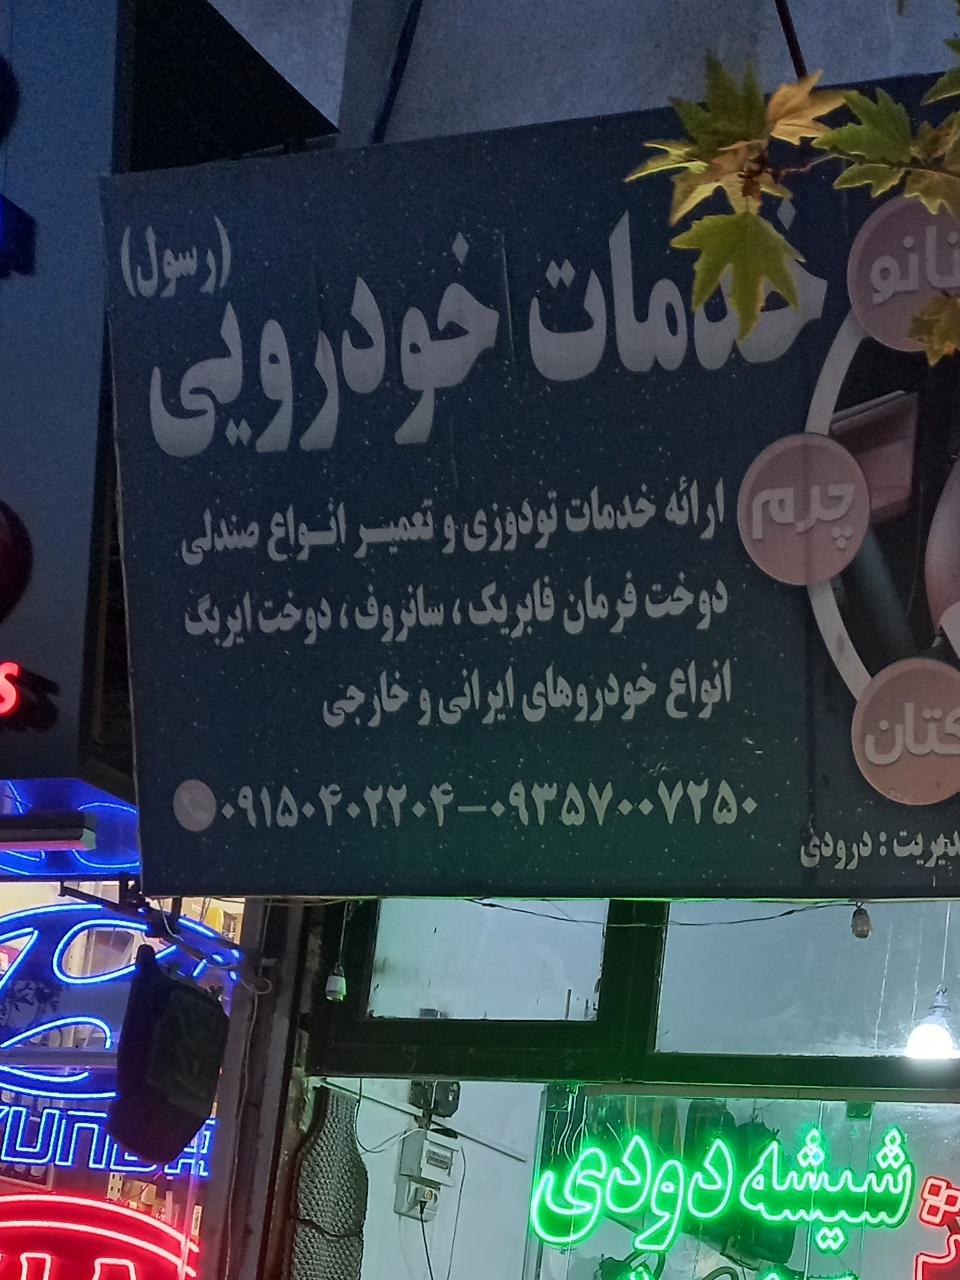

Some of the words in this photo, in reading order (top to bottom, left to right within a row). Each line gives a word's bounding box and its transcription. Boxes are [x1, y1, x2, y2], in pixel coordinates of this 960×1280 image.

[120, 214, 232, 298] (رسول)
[150, 231, 500, 459] خودرویی
[181, 506, 260, 567] صندلی
[443, 518, 458, 554] و
[463, 490, 559, 554] تودوزی
[565, 484, 656, 534] خدمات
[664, 476, 726, 541] ارائه
[752, 482, 855, 550] چرم
[184, 591, 253, 648] ایربگ
[258, 594, 331, 645] دوخت
[356, 583, 444, 643] سانروف
[468, 575, 556, 640] فابریک
[563, 570, 638, 635] فرمان
[645, 573, 729, 631] دوخت
[323, 669, 410, 728] خارجی
[417, 693, 432, 727] و
[438, 665, 515, 727] ایرانی
[522, 661, 657, 724] خودروهای
[667, 659, 732, 719] انواع
[801, 831, 872, 870] درودی
[531, 1135, 734, 1250] دودی
[739, 1128, 914, 1250] شیشه
